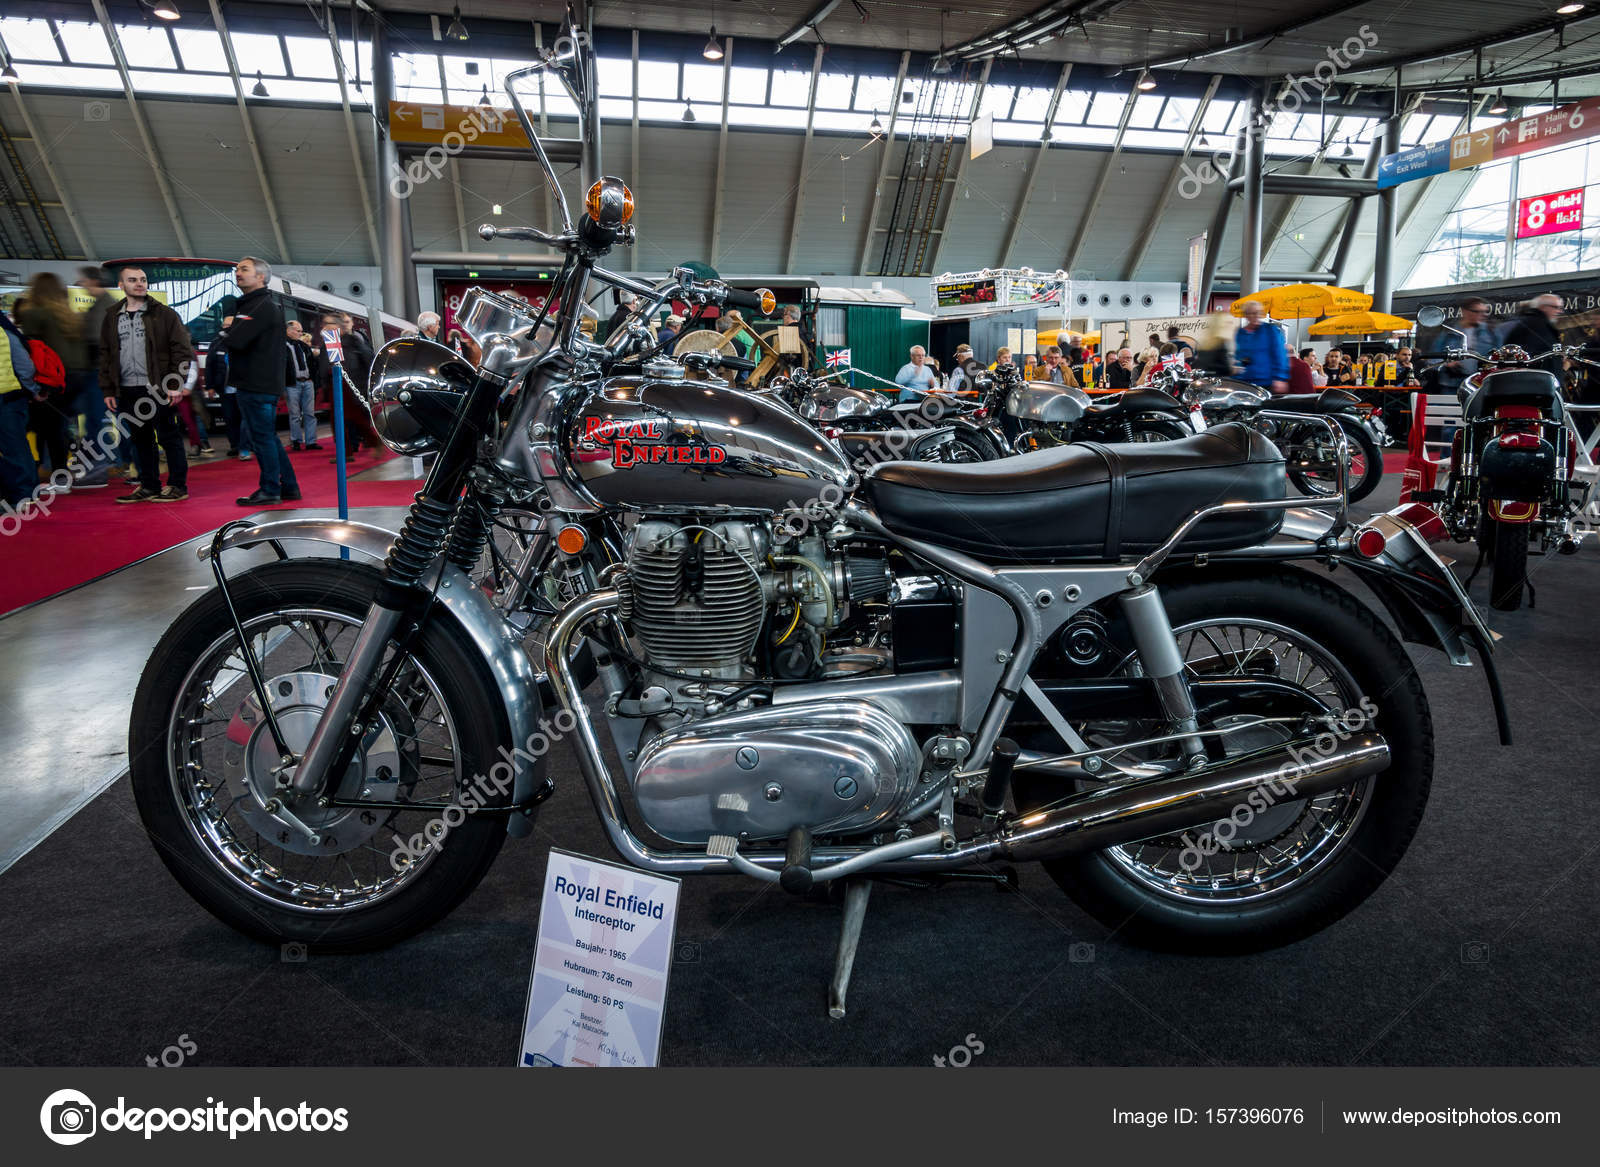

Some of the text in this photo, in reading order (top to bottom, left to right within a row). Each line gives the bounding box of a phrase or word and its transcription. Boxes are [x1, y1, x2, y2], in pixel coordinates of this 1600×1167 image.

[1544, 122, 1562, 136] Hall
[1545, 105, 1585, 129] Halle 6
[1396, 160, 1428, 174] Exit West
[1146, 322, 1160, 332] Der
[554, 876, 665, 920] Royal Enfield
[574, 906, 636, 933] Interceptor
[575, 939, 627, 961] Baujahr: 1965
[563, 959, 633, 989] Hubraum: 736 ccm
[566, 983, 624, 1010] Leistung: 50 PS
